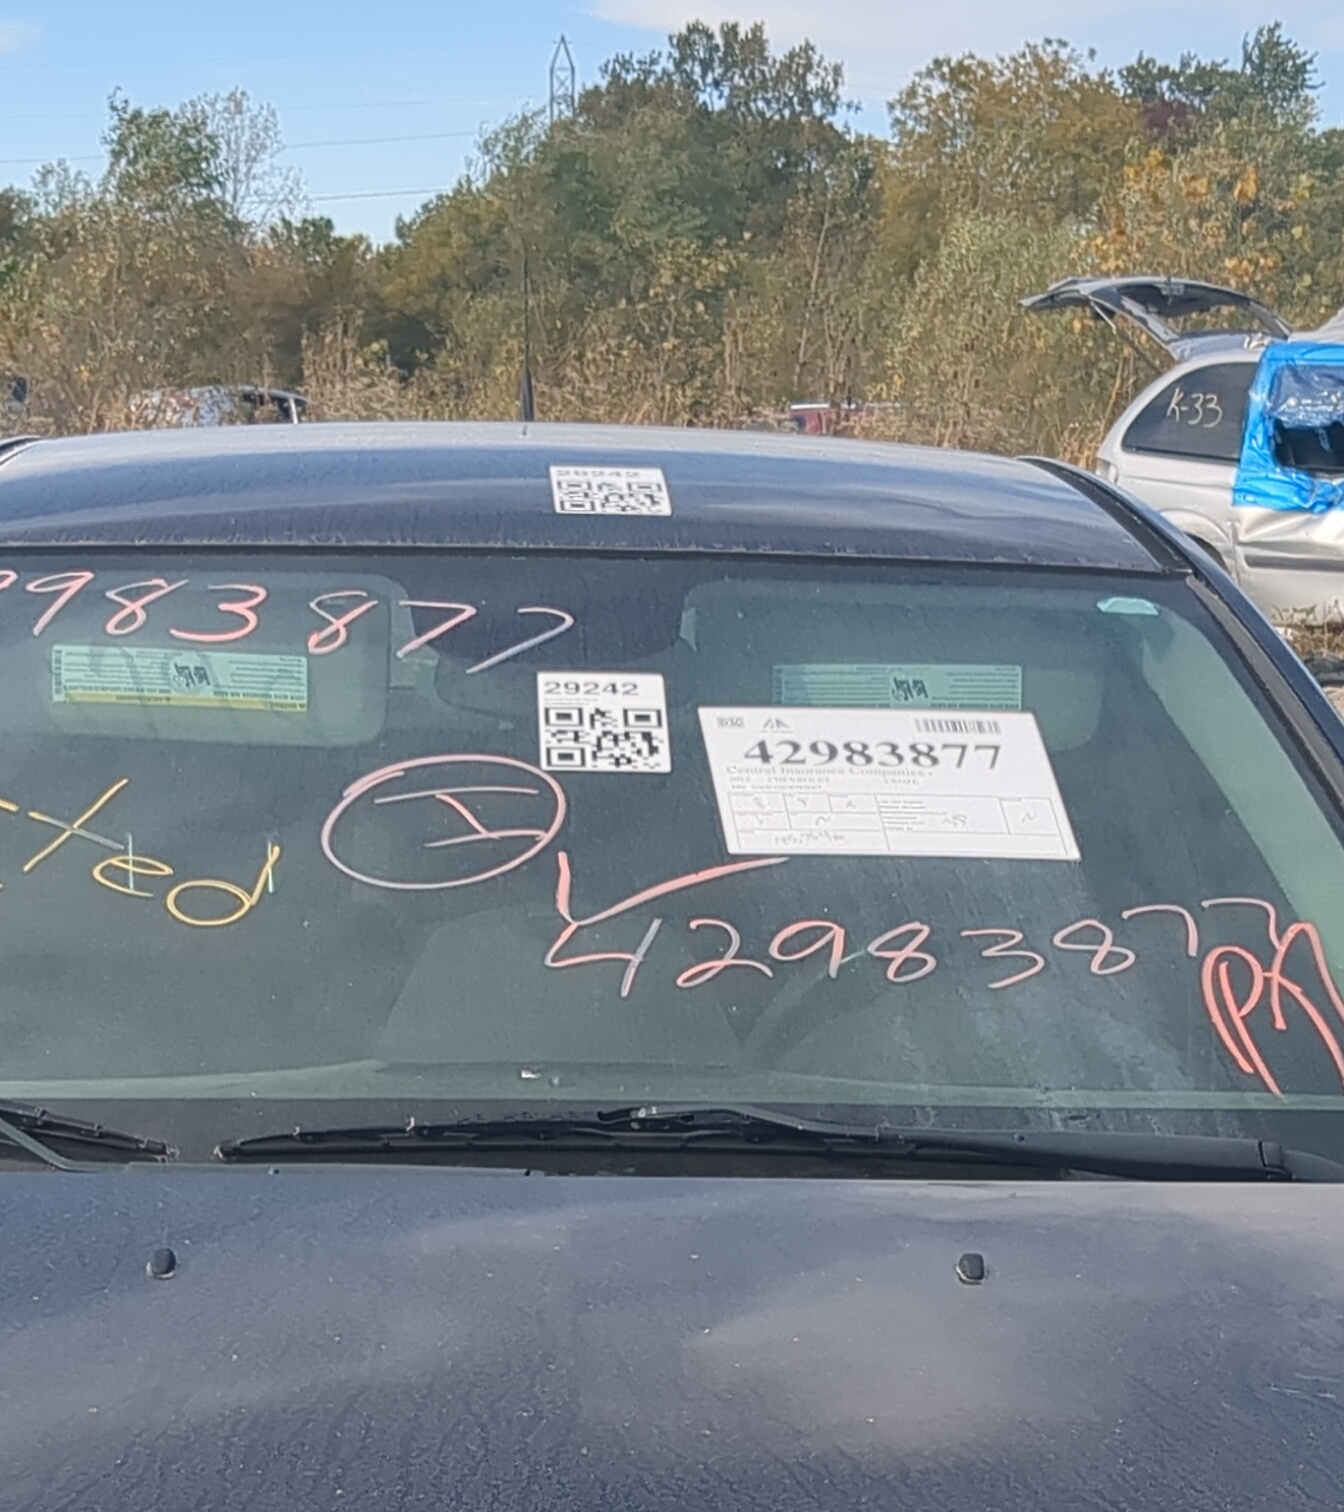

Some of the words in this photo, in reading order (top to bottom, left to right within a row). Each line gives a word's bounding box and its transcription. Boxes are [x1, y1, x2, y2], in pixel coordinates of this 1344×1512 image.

[1166, 387, 1223, 428] K-33
[543, 681, 640, 696] 29242
[743, 739, 1002, 769] 42983877
[726, 765, 777, 775] Central
[780, 766, 846, 776] Insurance
[544, 896, 1285, 998] 42983877
